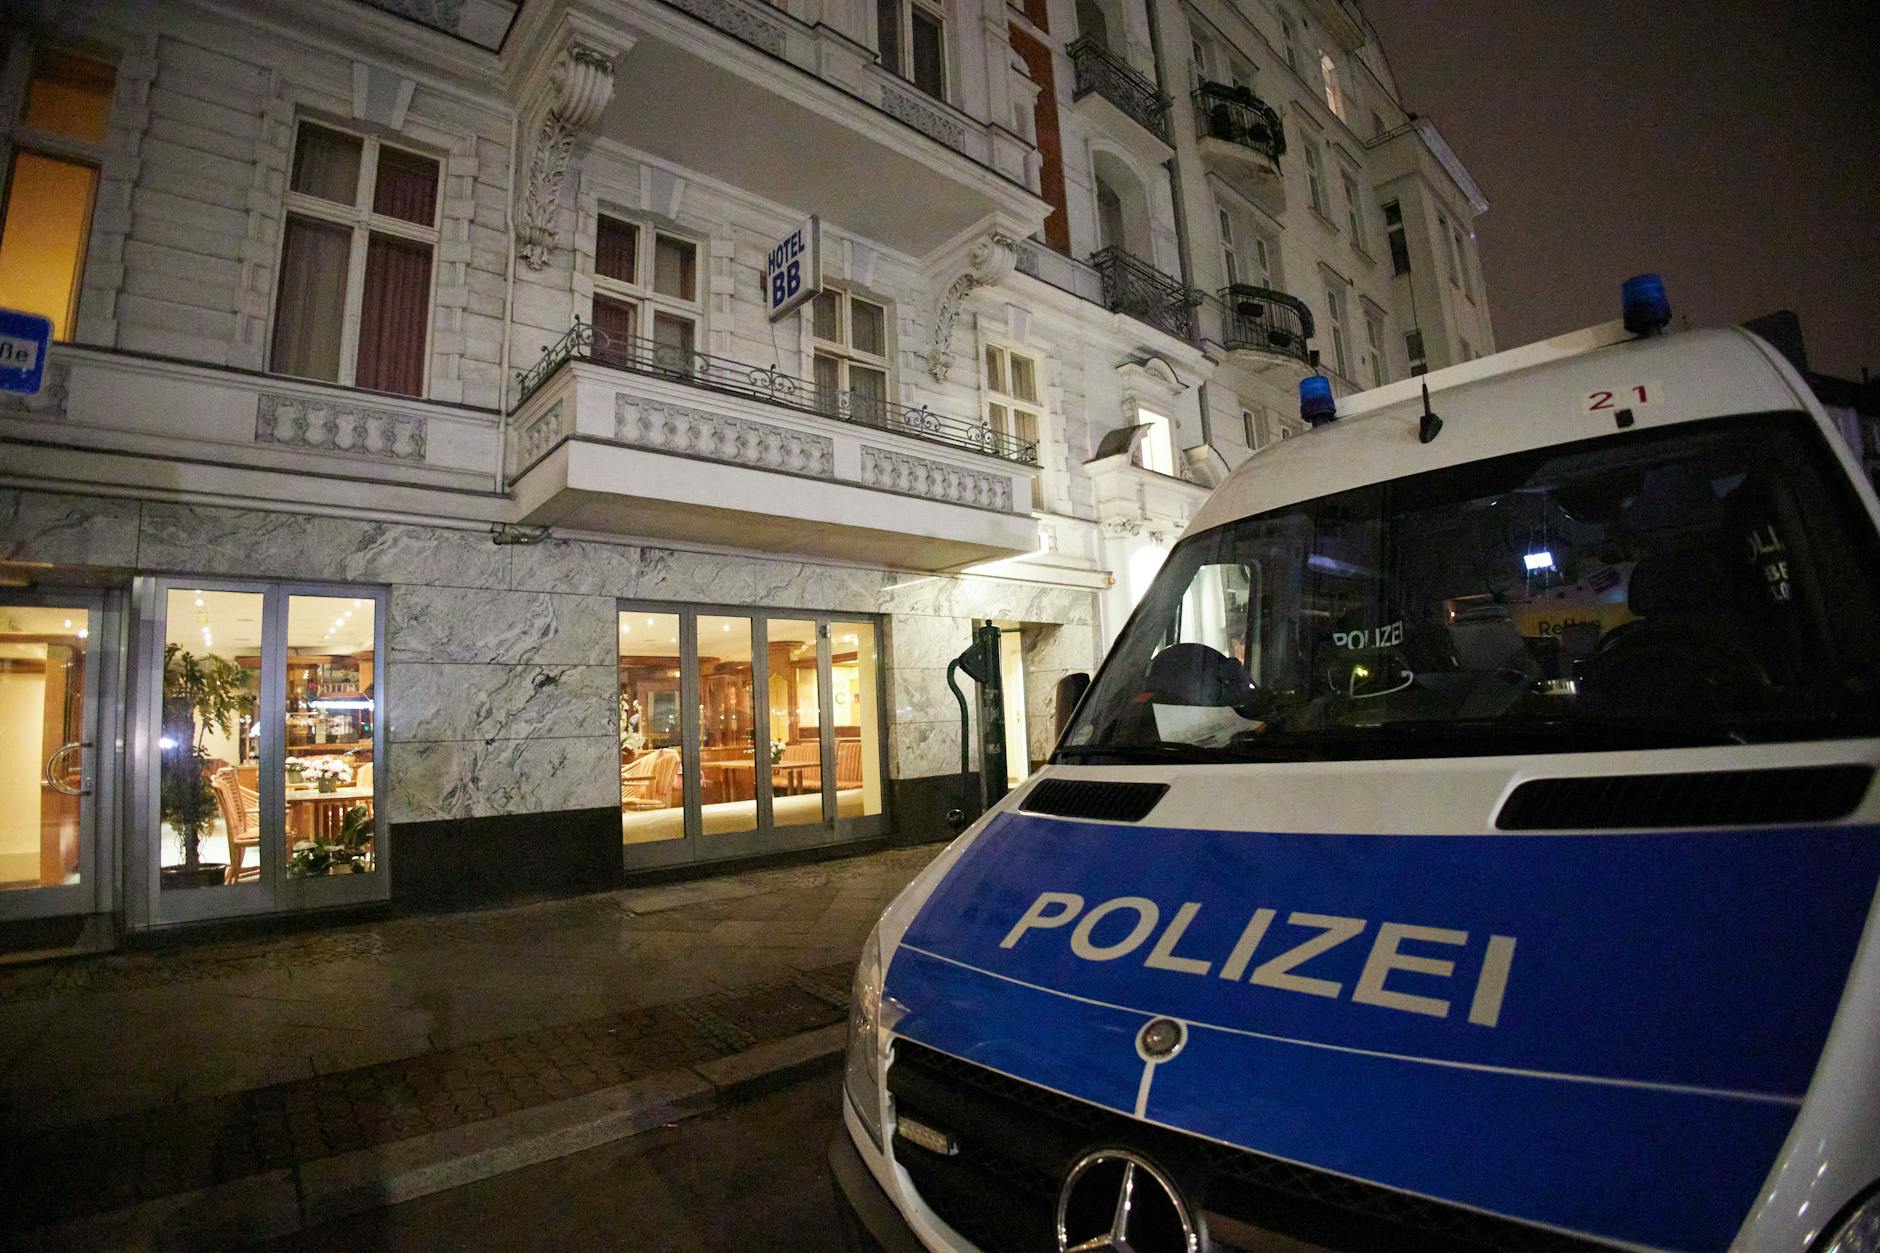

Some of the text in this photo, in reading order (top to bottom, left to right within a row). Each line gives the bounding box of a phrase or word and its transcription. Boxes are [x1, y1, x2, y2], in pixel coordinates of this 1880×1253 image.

[768, 229, 805, 276] HOTEL
[773, 260, 801, 309] BB
[1332, 620, 1404, 650] POLIZEI
[1000, 891, 1518, 1028] POLIZEI
